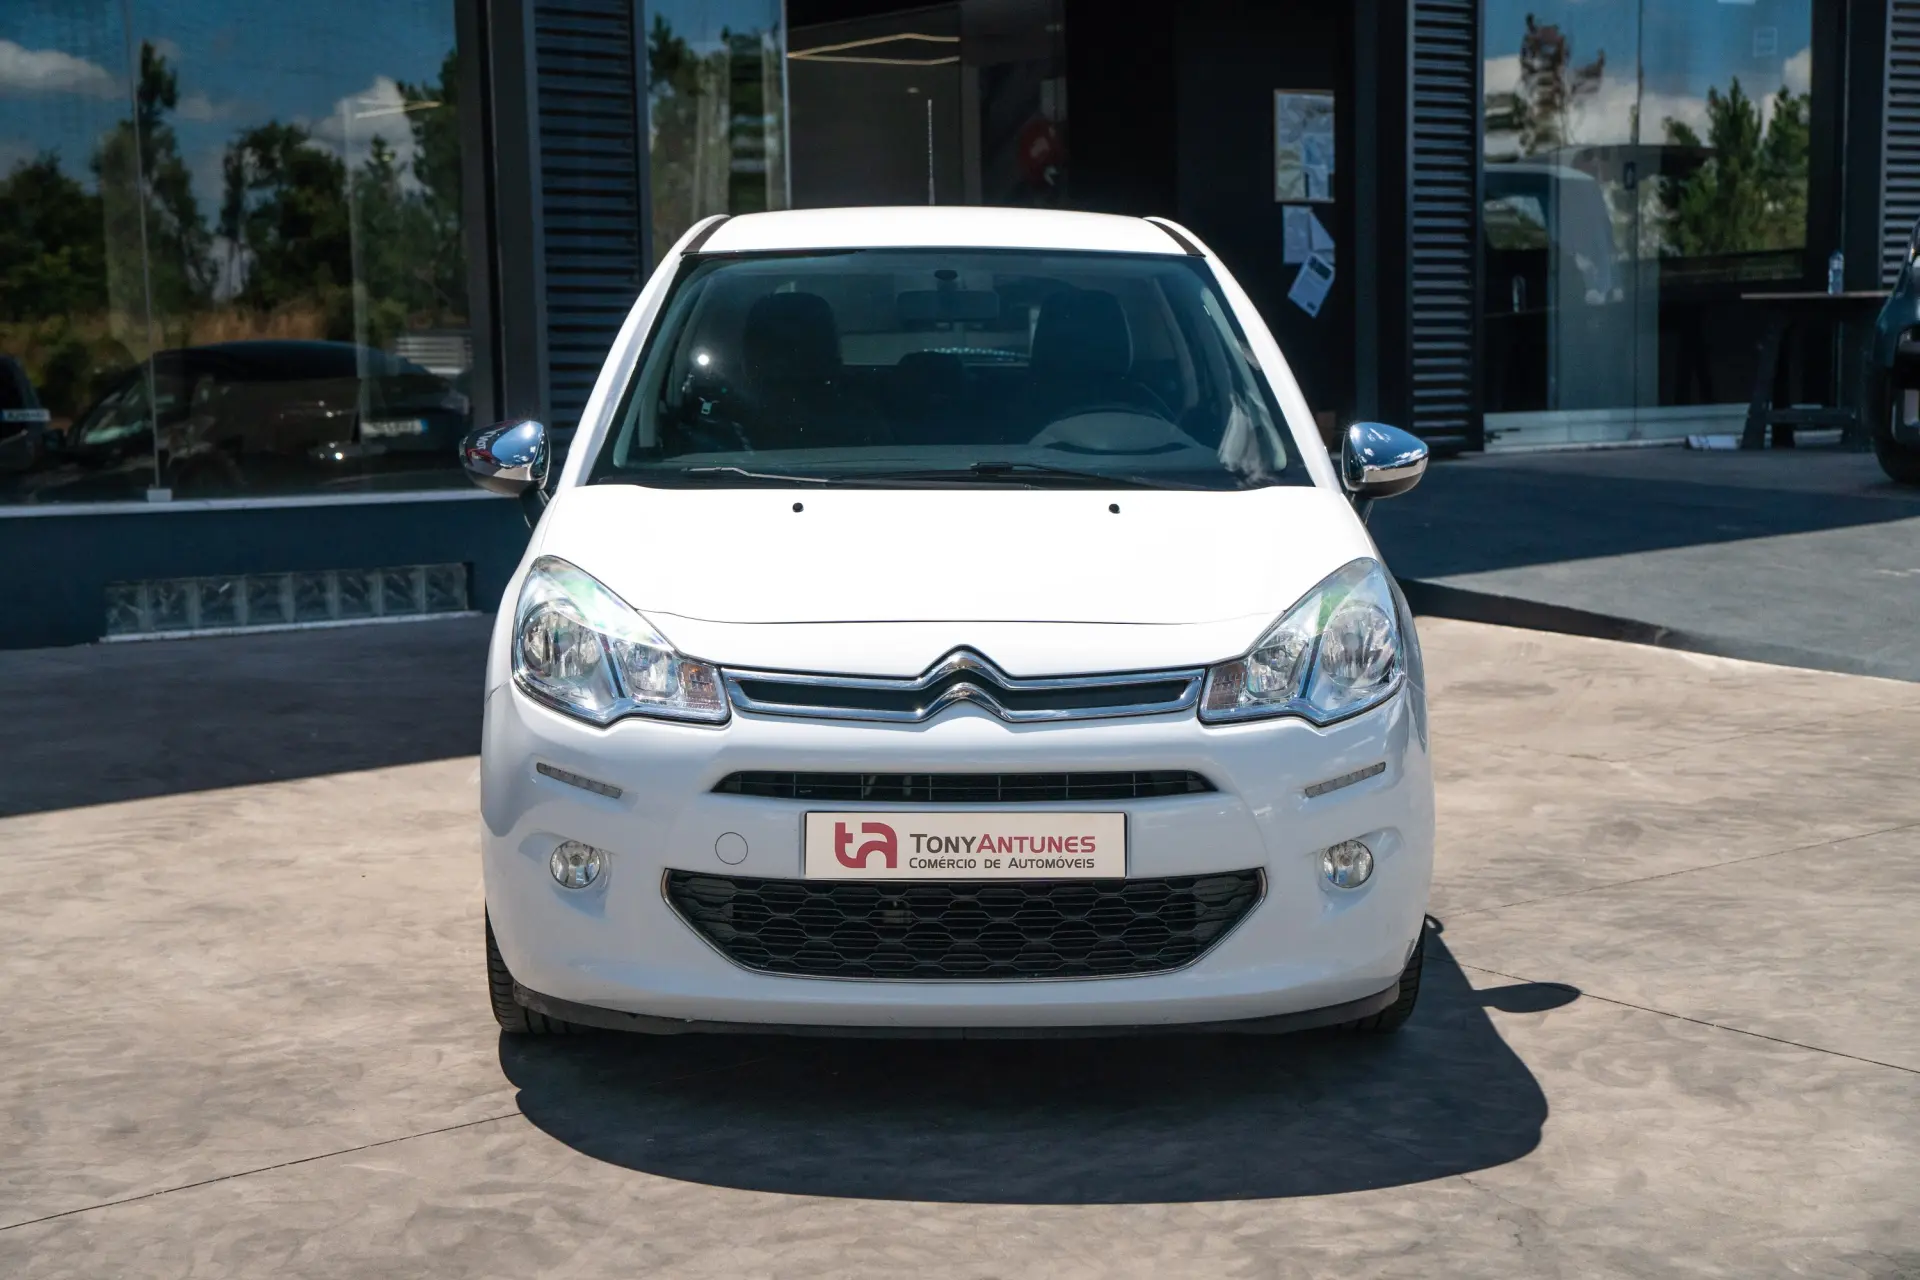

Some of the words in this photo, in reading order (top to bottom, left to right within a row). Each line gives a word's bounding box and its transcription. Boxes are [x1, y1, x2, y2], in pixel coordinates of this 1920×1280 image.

[909, 856, 977, 869] COMÉRCIO
[984, 858, 1001, 869] DE
[1007, 855, 1095, 869] AUTOMÓVEIS
